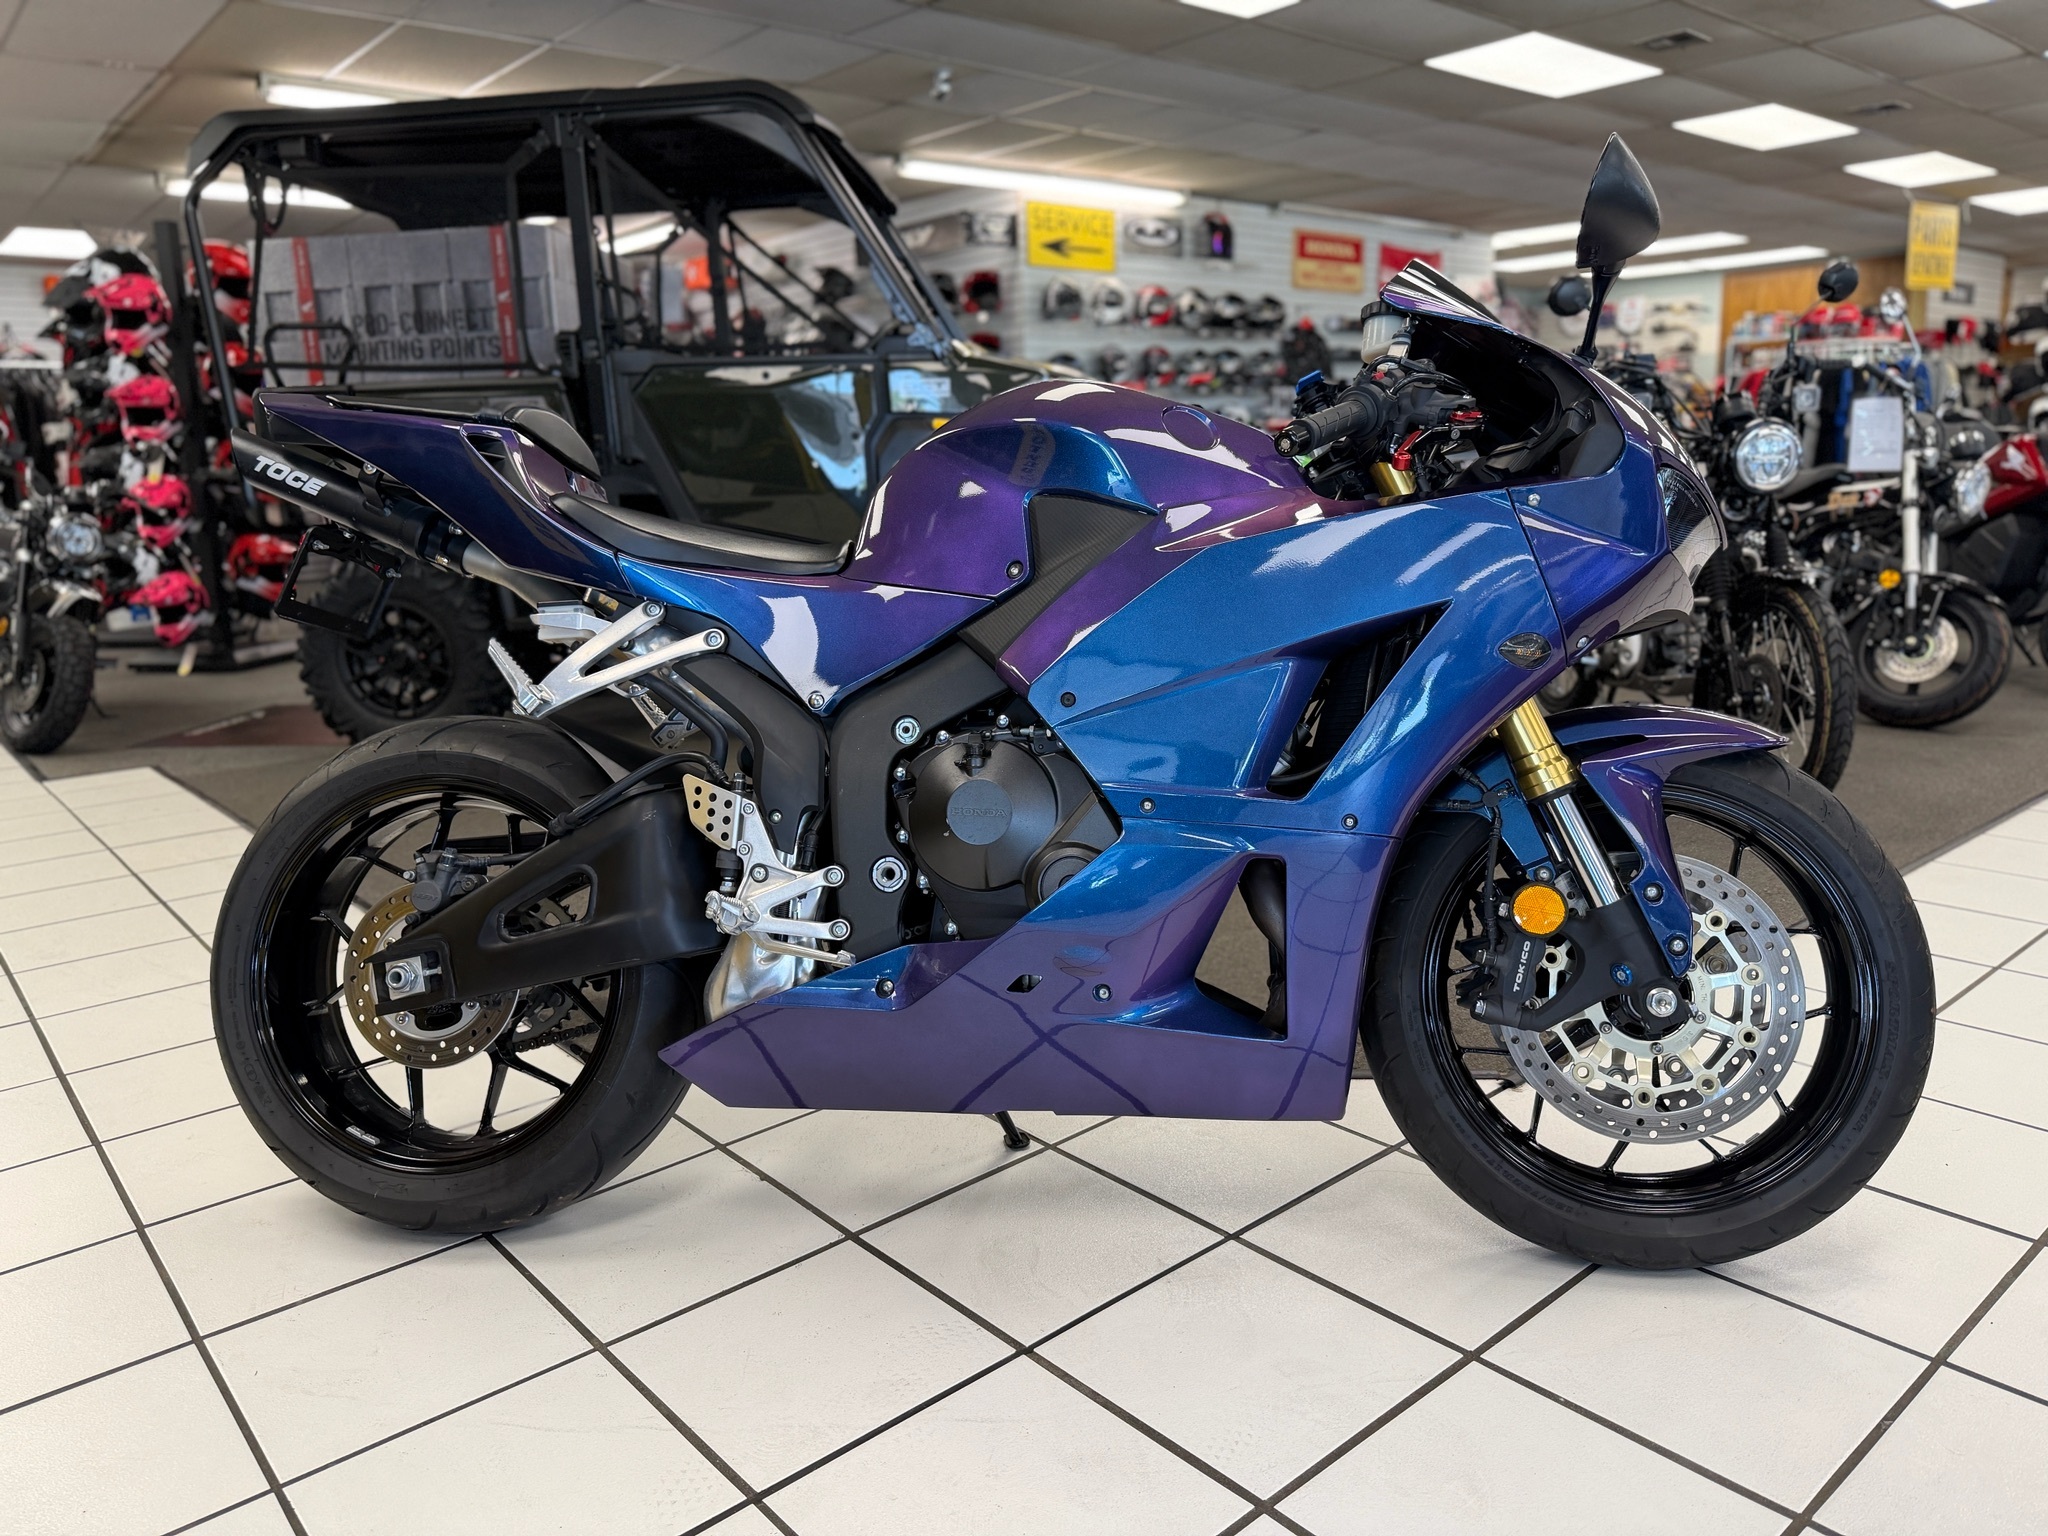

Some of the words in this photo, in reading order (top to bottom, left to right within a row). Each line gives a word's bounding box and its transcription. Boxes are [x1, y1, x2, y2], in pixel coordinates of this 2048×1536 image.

[1032, 206, 1114, 239] SERVICE
[430, 334, 502, 360] POINTS
[253, 455, 328, 497] TOCE
[951, 806, 1008, 818] HONDA
[1512, 940, 1531, 993] TOKICO
